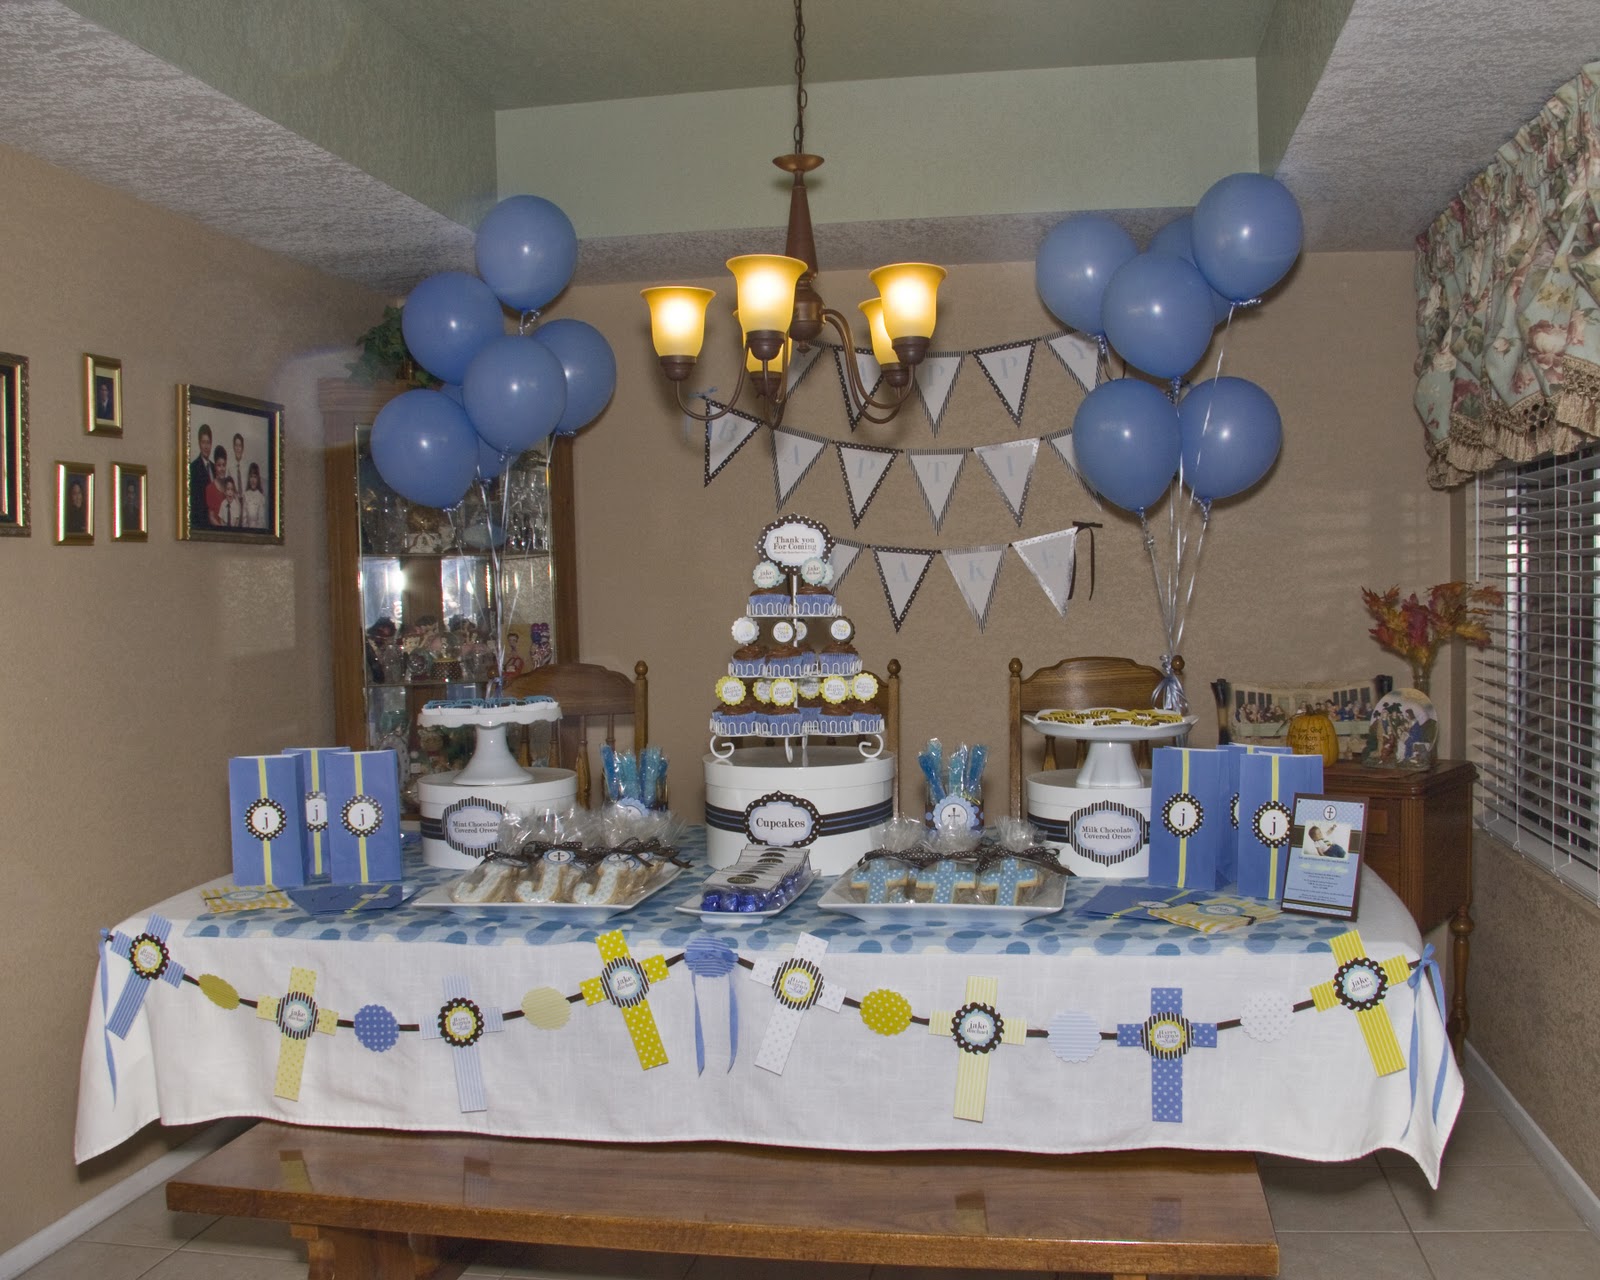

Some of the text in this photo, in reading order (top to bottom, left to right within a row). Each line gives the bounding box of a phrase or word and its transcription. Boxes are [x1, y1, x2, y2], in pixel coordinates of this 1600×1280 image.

[774, 536, 799, 544] Thank
[788, 543, 817, 551] Coming
[452, 820, 467, 828] Mint
[756, 817, 806, 830] Cupcakes
[1081, 825, 1134, 834] Milk Chocolate
[1083, 833, 1110, 841] Covered
